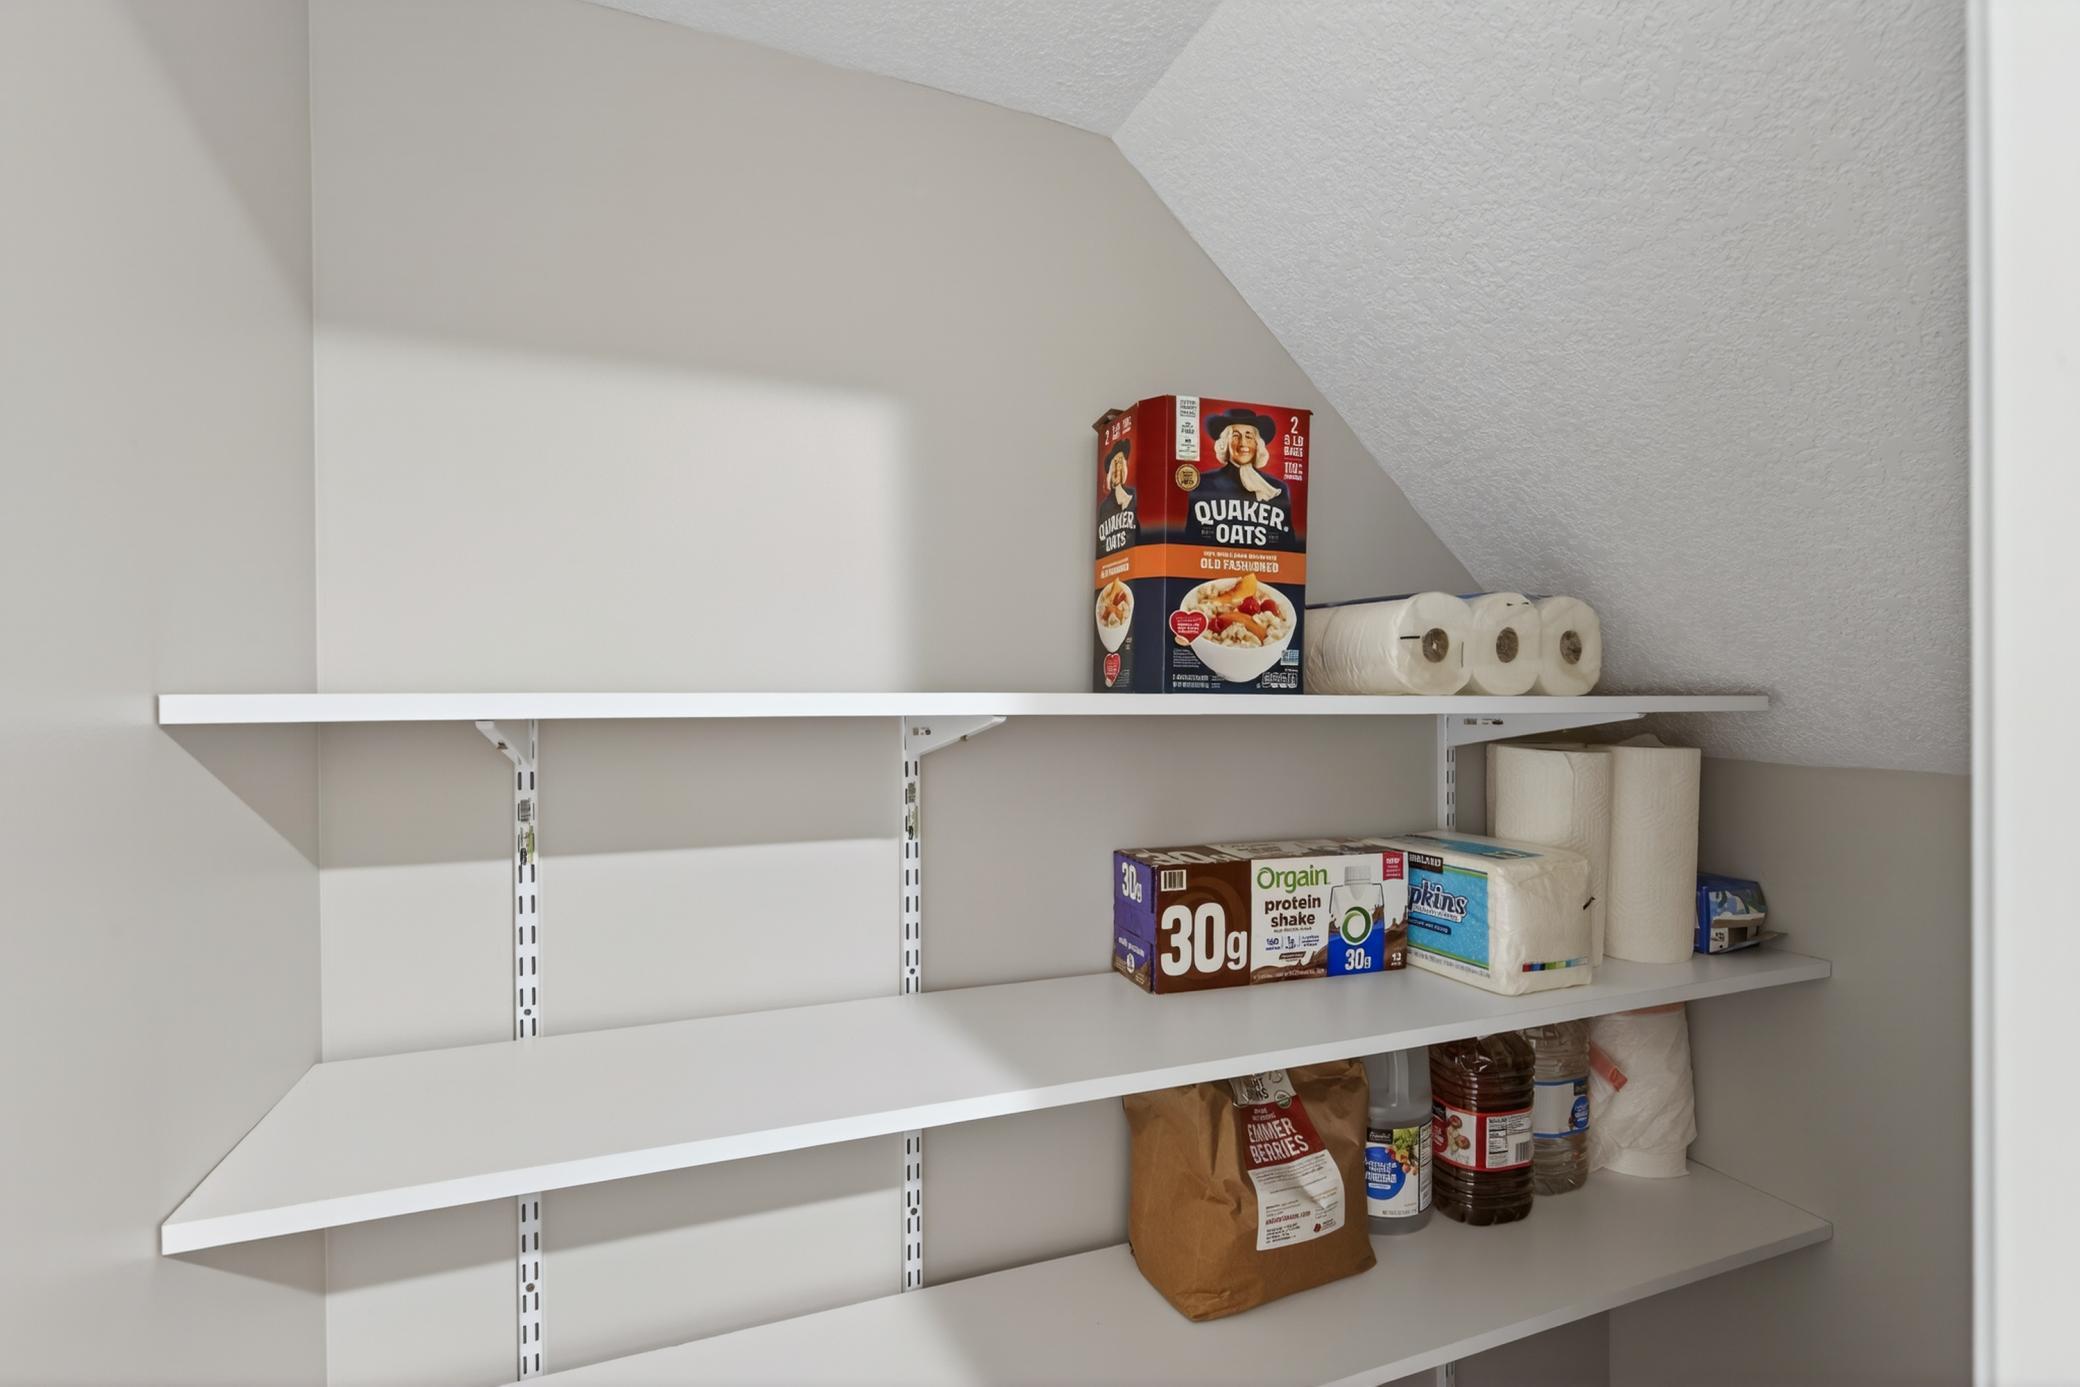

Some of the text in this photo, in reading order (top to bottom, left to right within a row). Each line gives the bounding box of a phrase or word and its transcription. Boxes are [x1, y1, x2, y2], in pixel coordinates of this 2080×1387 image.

[1290, 416, 1299, 435] 2
[1106, 531, 1126, 552] OATS
[1216, 523, 1267, 546] OATS
[1200, 558, 1279, 574] OLD FASHIONED
[1122, 862, 1143, 904] 30g
[1257, 865, 1328, 893] Orgain
[1264, 895, 1322, 915] protein
[1408, 880, 1468, 915] pkins
[1271, 912, 1316, 928] shake
[1161, 902, 1248, 977] 30g
[1247, 1117, 1297, 1143] EMMER
[1250, 1135, 1309, 1164] BERRIES
